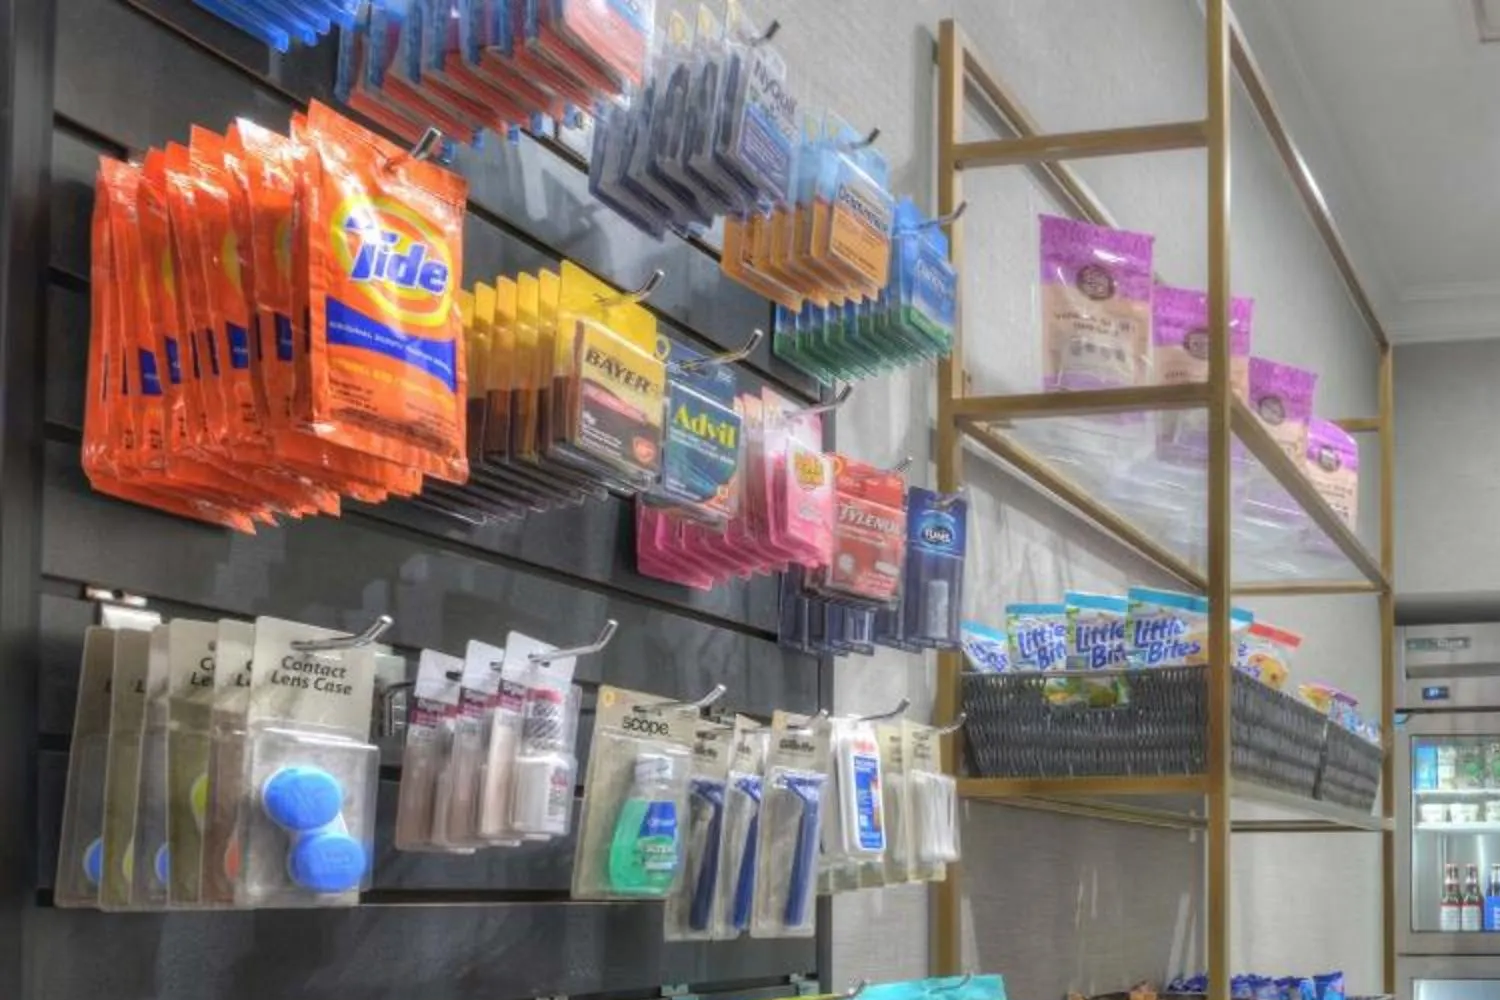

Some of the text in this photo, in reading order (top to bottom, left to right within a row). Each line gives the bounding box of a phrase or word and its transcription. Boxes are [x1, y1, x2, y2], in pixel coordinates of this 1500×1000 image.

[344, 214, 449, 294] Tide
[585, 350, 651, 393] BAYER
[673, 404, 736, 449] Advil
[281, 655, 348, 679] Contact
[1149, 640, 1201, 665] Bites
[271, 669, 353, 696] Lens Case
